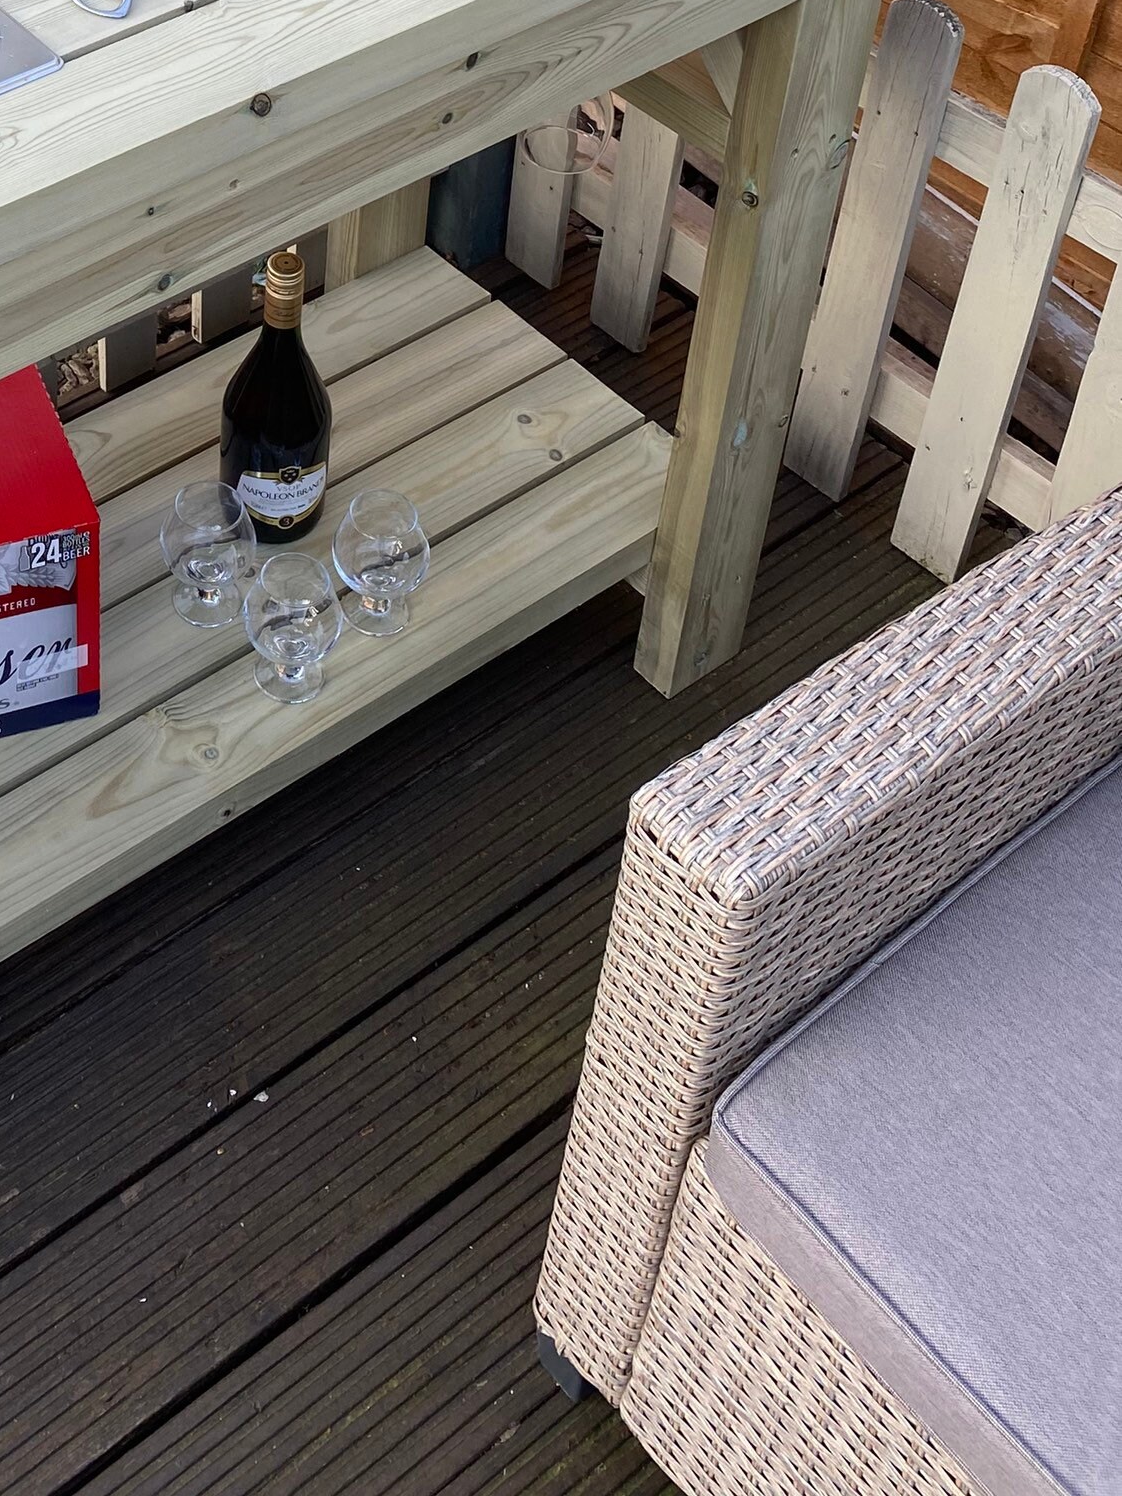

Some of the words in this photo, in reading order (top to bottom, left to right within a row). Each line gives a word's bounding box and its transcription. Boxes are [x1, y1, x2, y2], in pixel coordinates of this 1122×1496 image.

[242, 482, 296, 501] NAPOLEON
[276, 483, 301, 493] VSOP
[31, 537, 63, 569] 24
[62, 545, 91, 562] BEER
